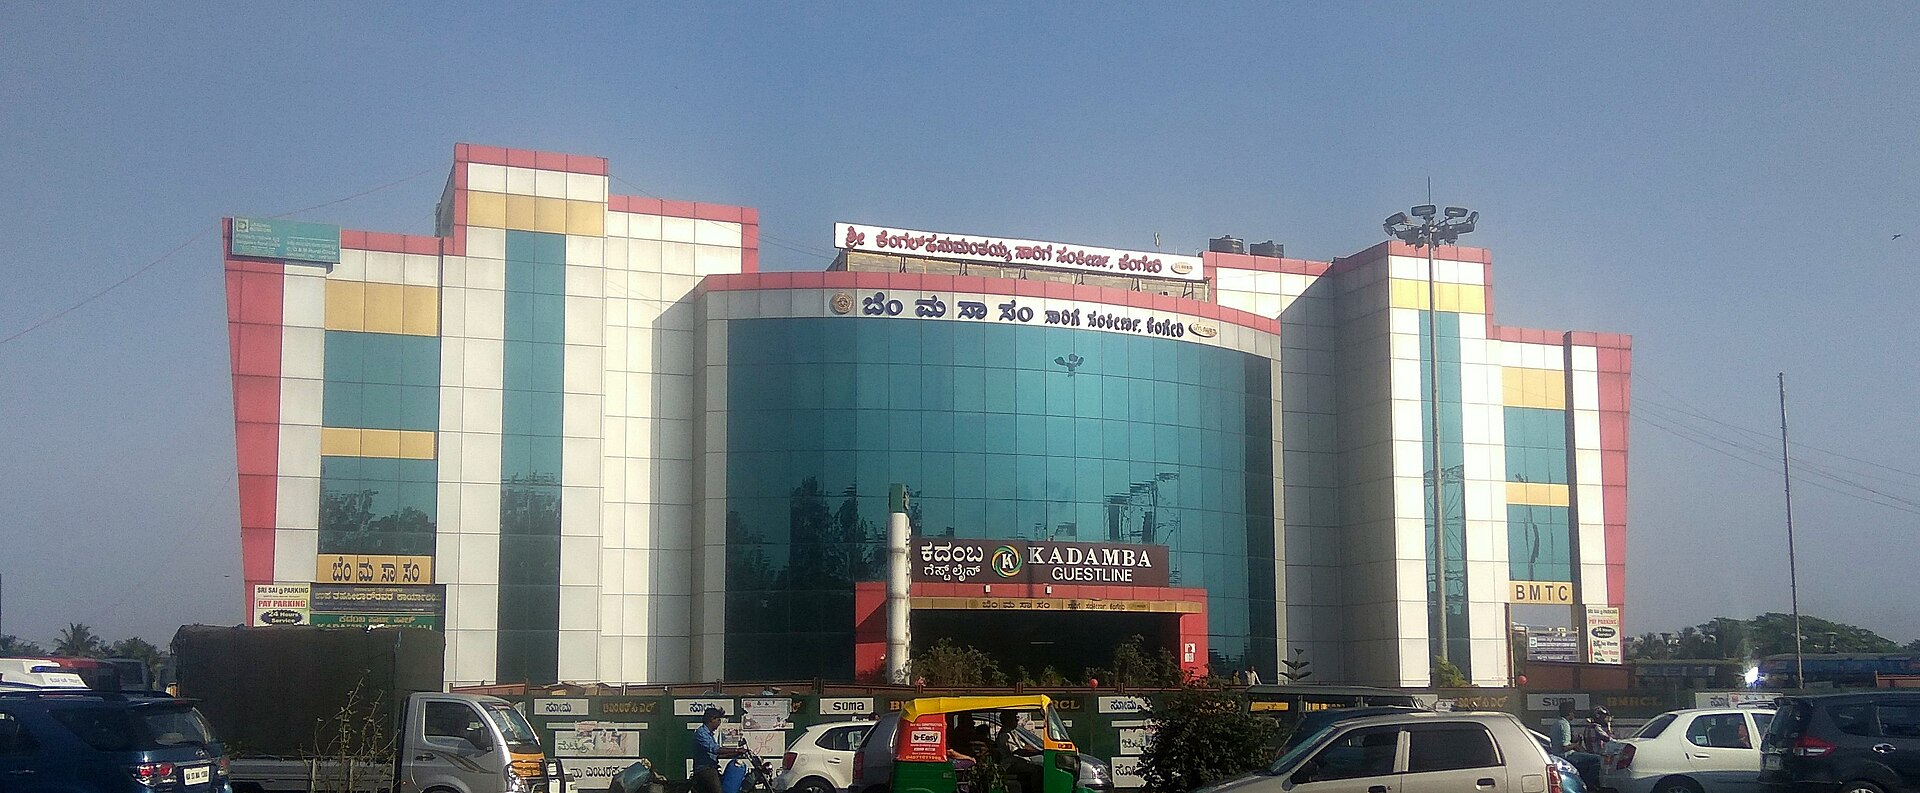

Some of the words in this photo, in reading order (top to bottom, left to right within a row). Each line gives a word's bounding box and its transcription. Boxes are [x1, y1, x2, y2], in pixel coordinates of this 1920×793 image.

[862, 292, 904, 316] ಬೆಂ
[914, 295, 946, 318] ಮ
[958, 300, 988, 320] ಸಾ
[998, 300, 1034, 322] ಸಂ
[921, 541, 984, 563] ಕದಂಬ
[1028, 547, 1152, 567] KADAMBA
[332, 556, 352, 582] ಬೆಂ
[358, 558, 374, 582] ಮ
[402, 558, 420, 582] ಸಂ
[1052, 566, 1132, 582] GUESTLINE
[1516, 584, 1568, 601] BMTC
[274, 600, 306, 608] PARKING
